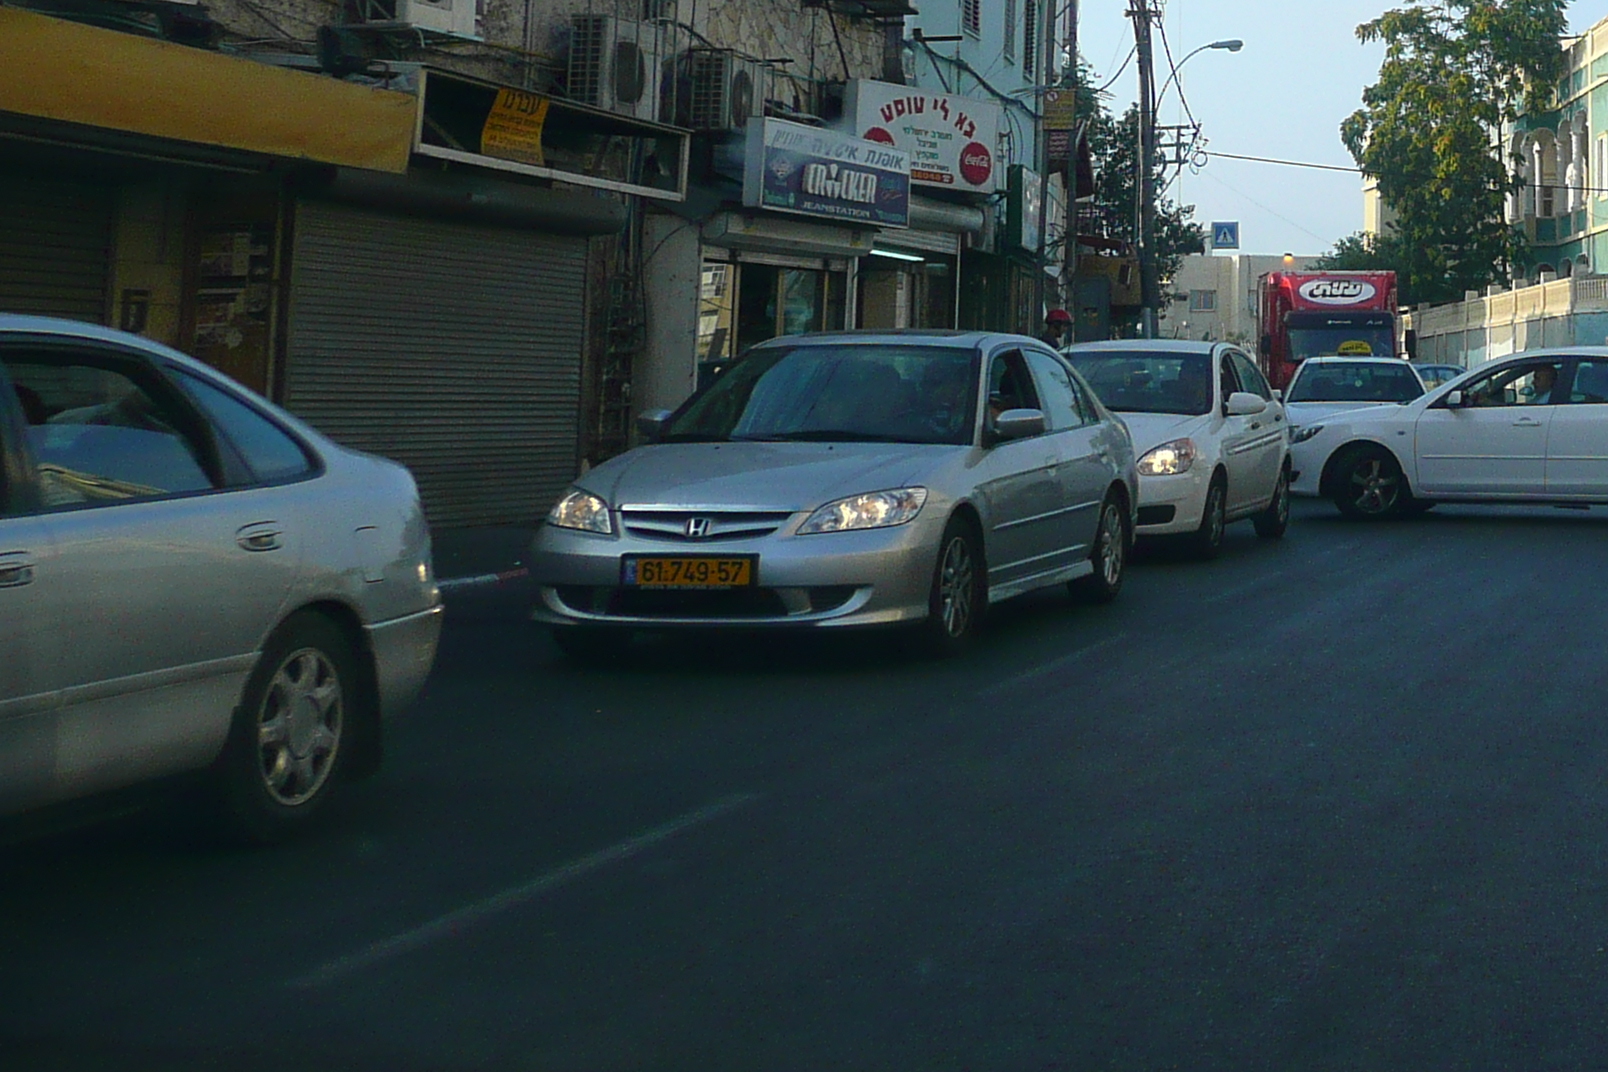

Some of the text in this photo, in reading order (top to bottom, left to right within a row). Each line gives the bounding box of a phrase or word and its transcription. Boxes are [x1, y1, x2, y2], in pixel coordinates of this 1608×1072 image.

[880, 96, 976, 139] בא לי טוסט
[864, 148, 905, 170] אופנת
